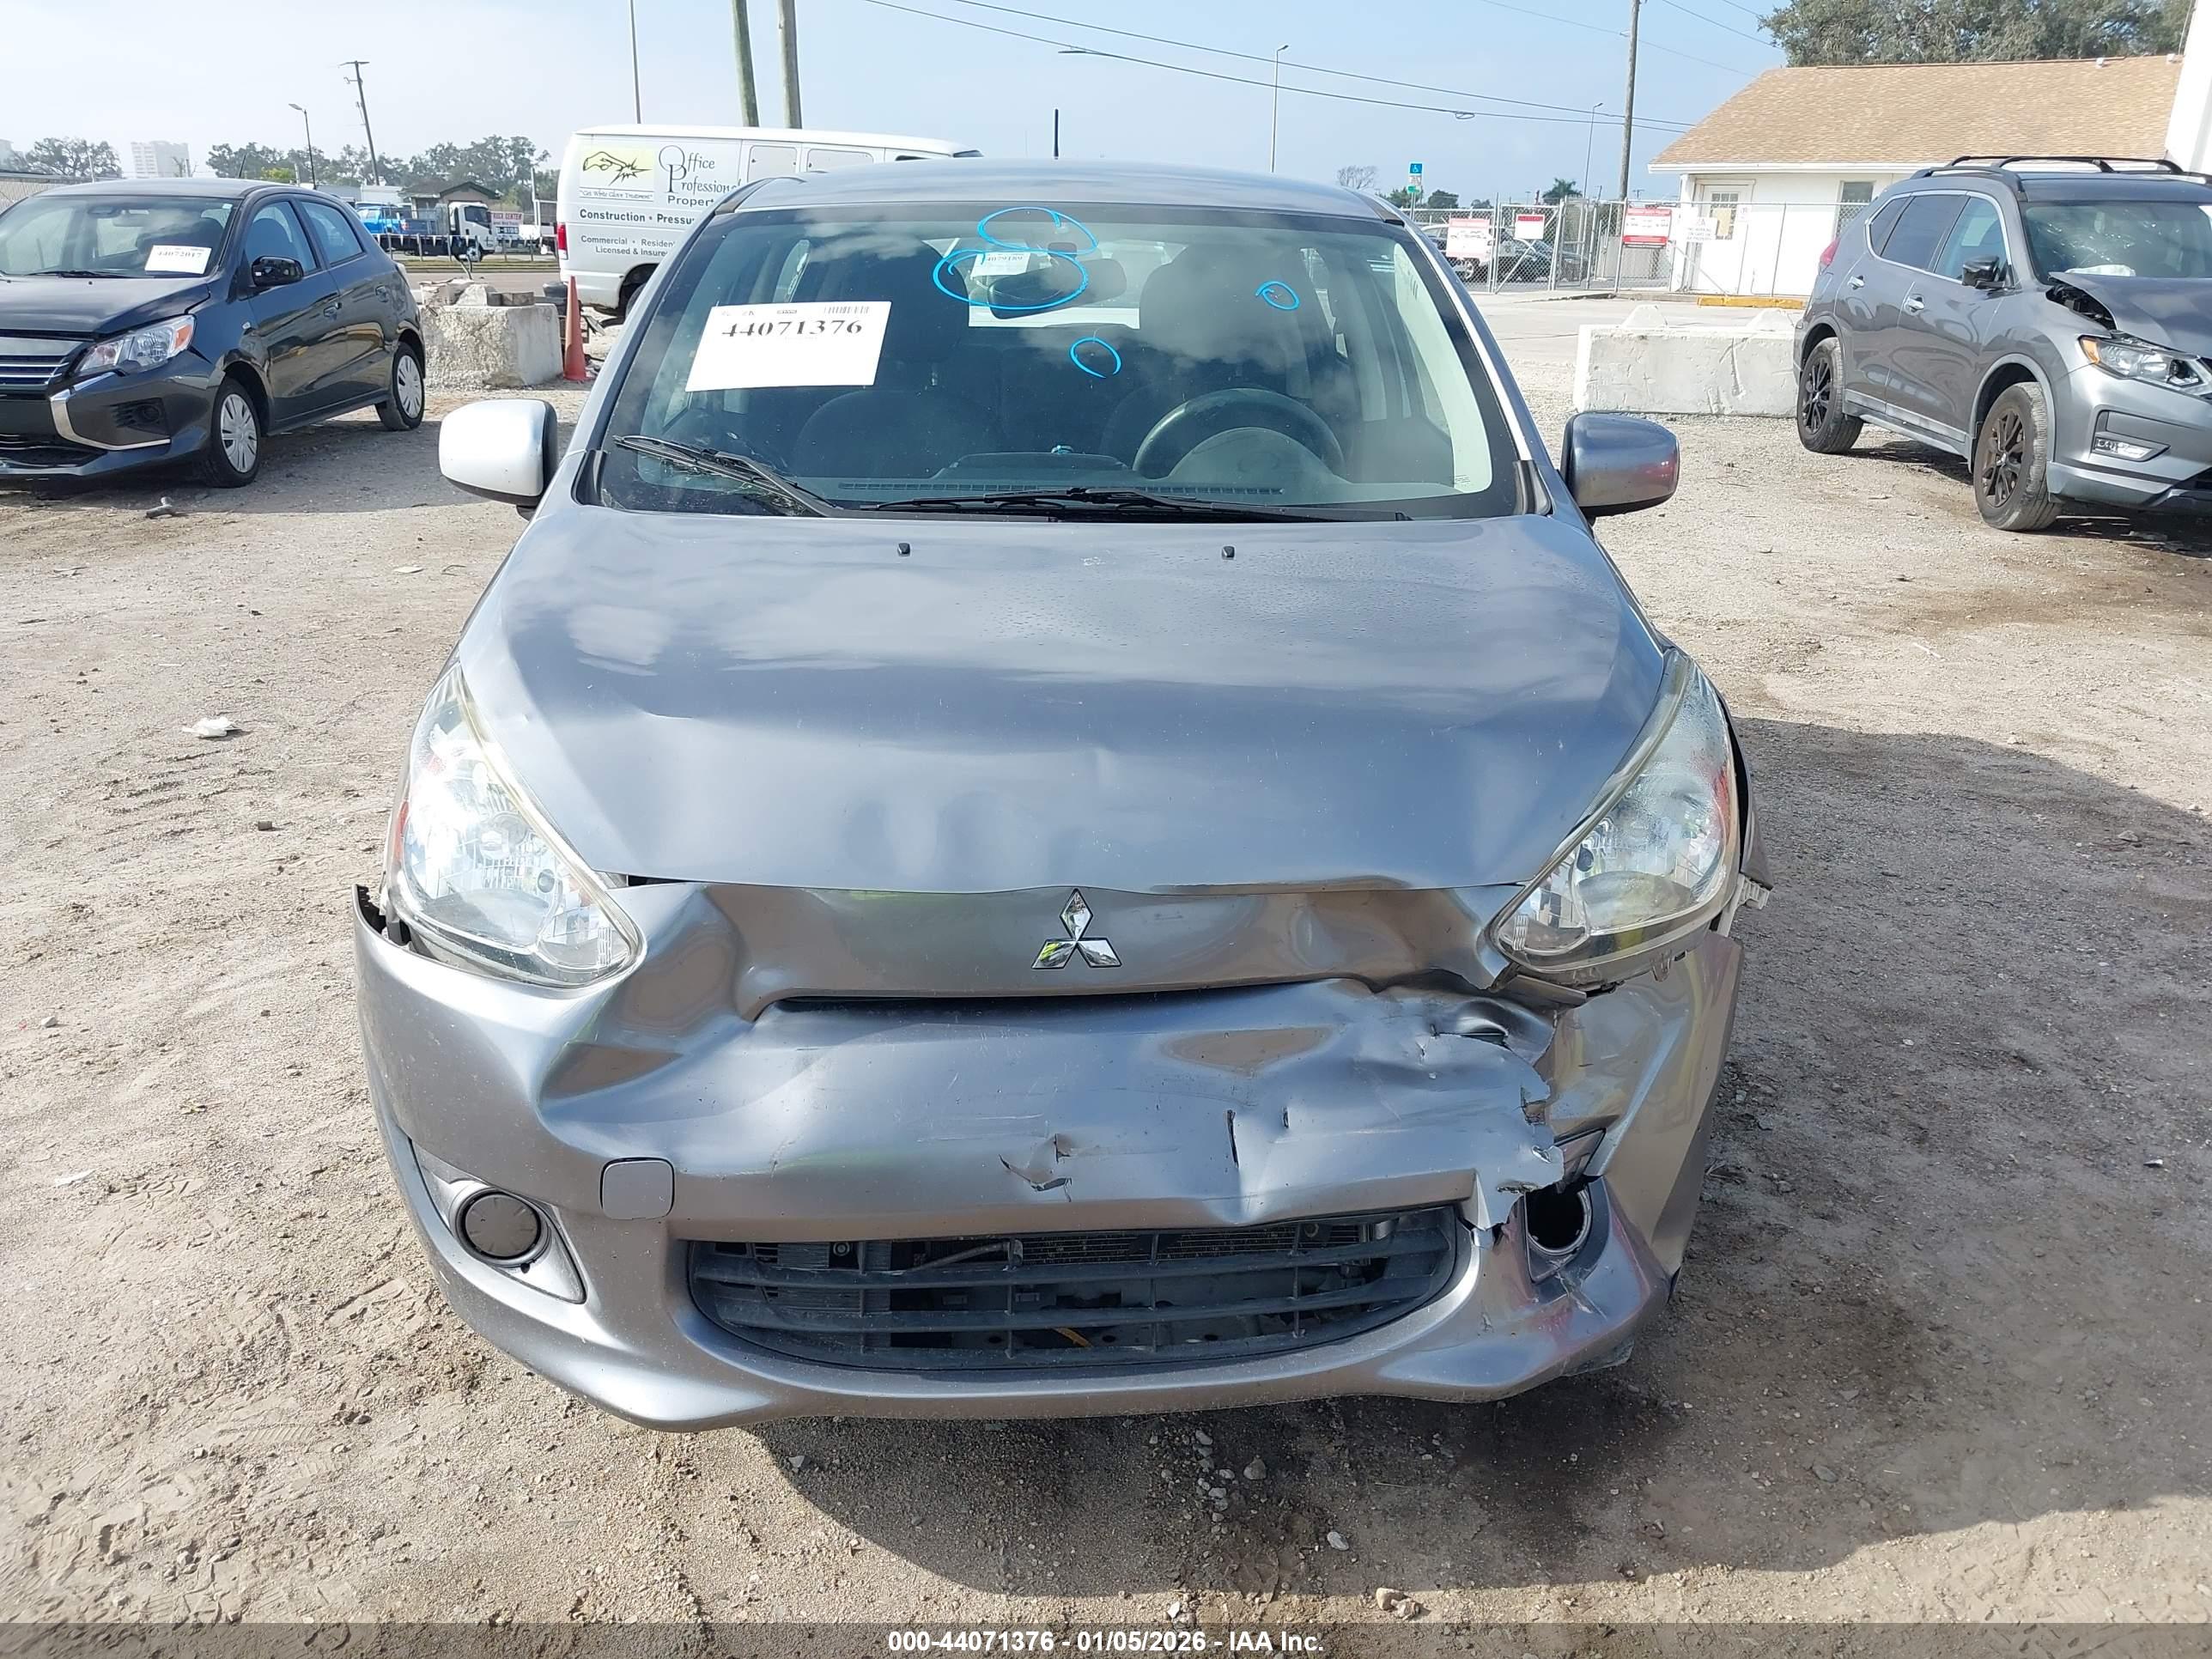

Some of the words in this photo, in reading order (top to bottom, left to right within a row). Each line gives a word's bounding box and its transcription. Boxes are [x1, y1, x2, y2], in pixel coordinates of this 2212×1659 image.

[659, 144, 715, 172] Office
[580, 209, 646, 222] Construction
[580, 235, 628, 245] Commercial
[641, 239, 675, 247] Residen
[596, 246, 631, 255] Licensed
[722, 319, 863, 337] 44071376
